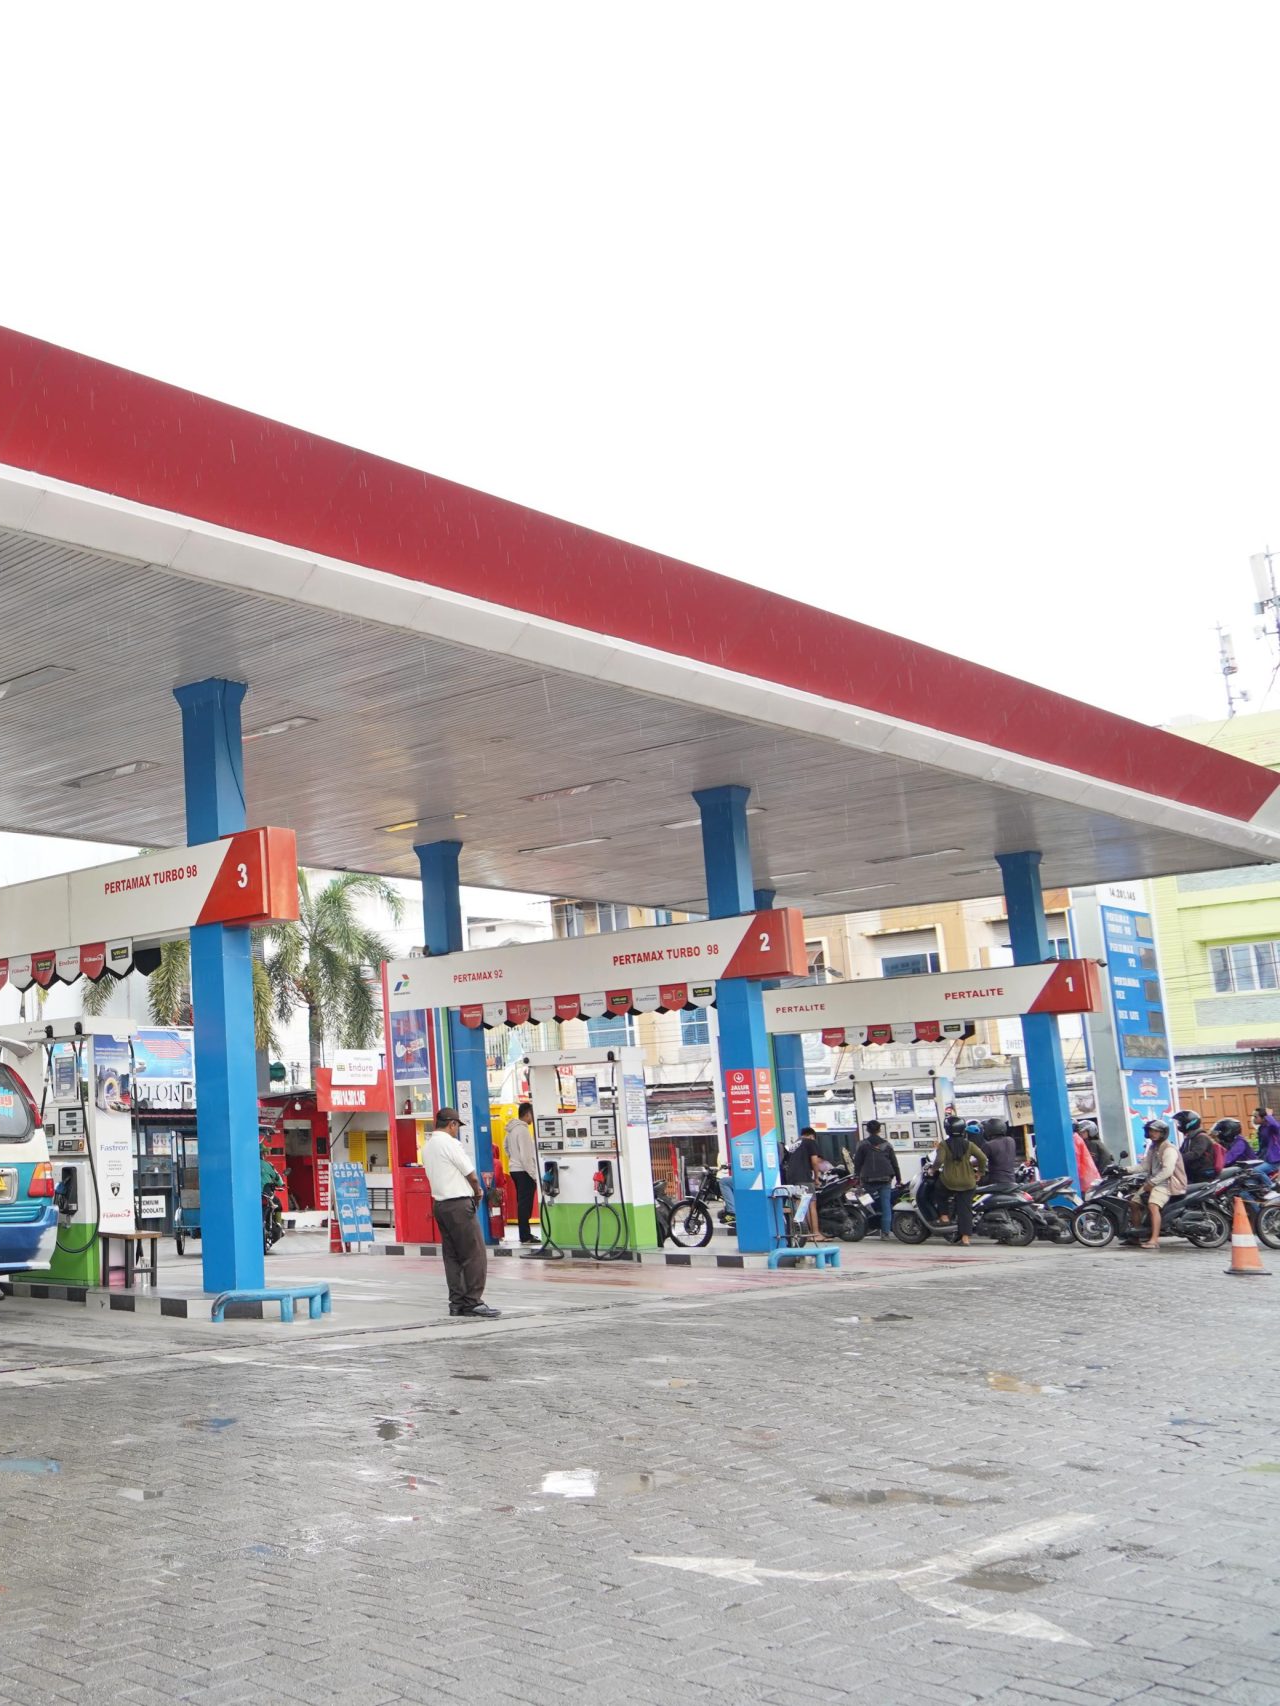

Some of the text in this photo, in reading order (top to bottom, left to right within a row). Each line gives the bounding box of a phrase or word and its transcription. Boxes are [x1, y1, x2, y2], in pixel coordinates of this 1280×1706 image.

[104, 865, 198, 895] PERTAMAX TURBO 98
[237, 863, 249, 888] 3
[759, 933, 770, 951] 2
[613, 944, 719, 966] PERTAMAX TURBO 98
[453, 970, 503, 983] PERTAMAX 92
[1065, 976, 1074, 992] 1
[944, 988, 1004, 1000] PERTALITE
[775, 1003, 826, 1014] PERTALITE
[348, 1063, 374, 1071] Enduro
[334, 1170, 365, 1178] CEPAT
